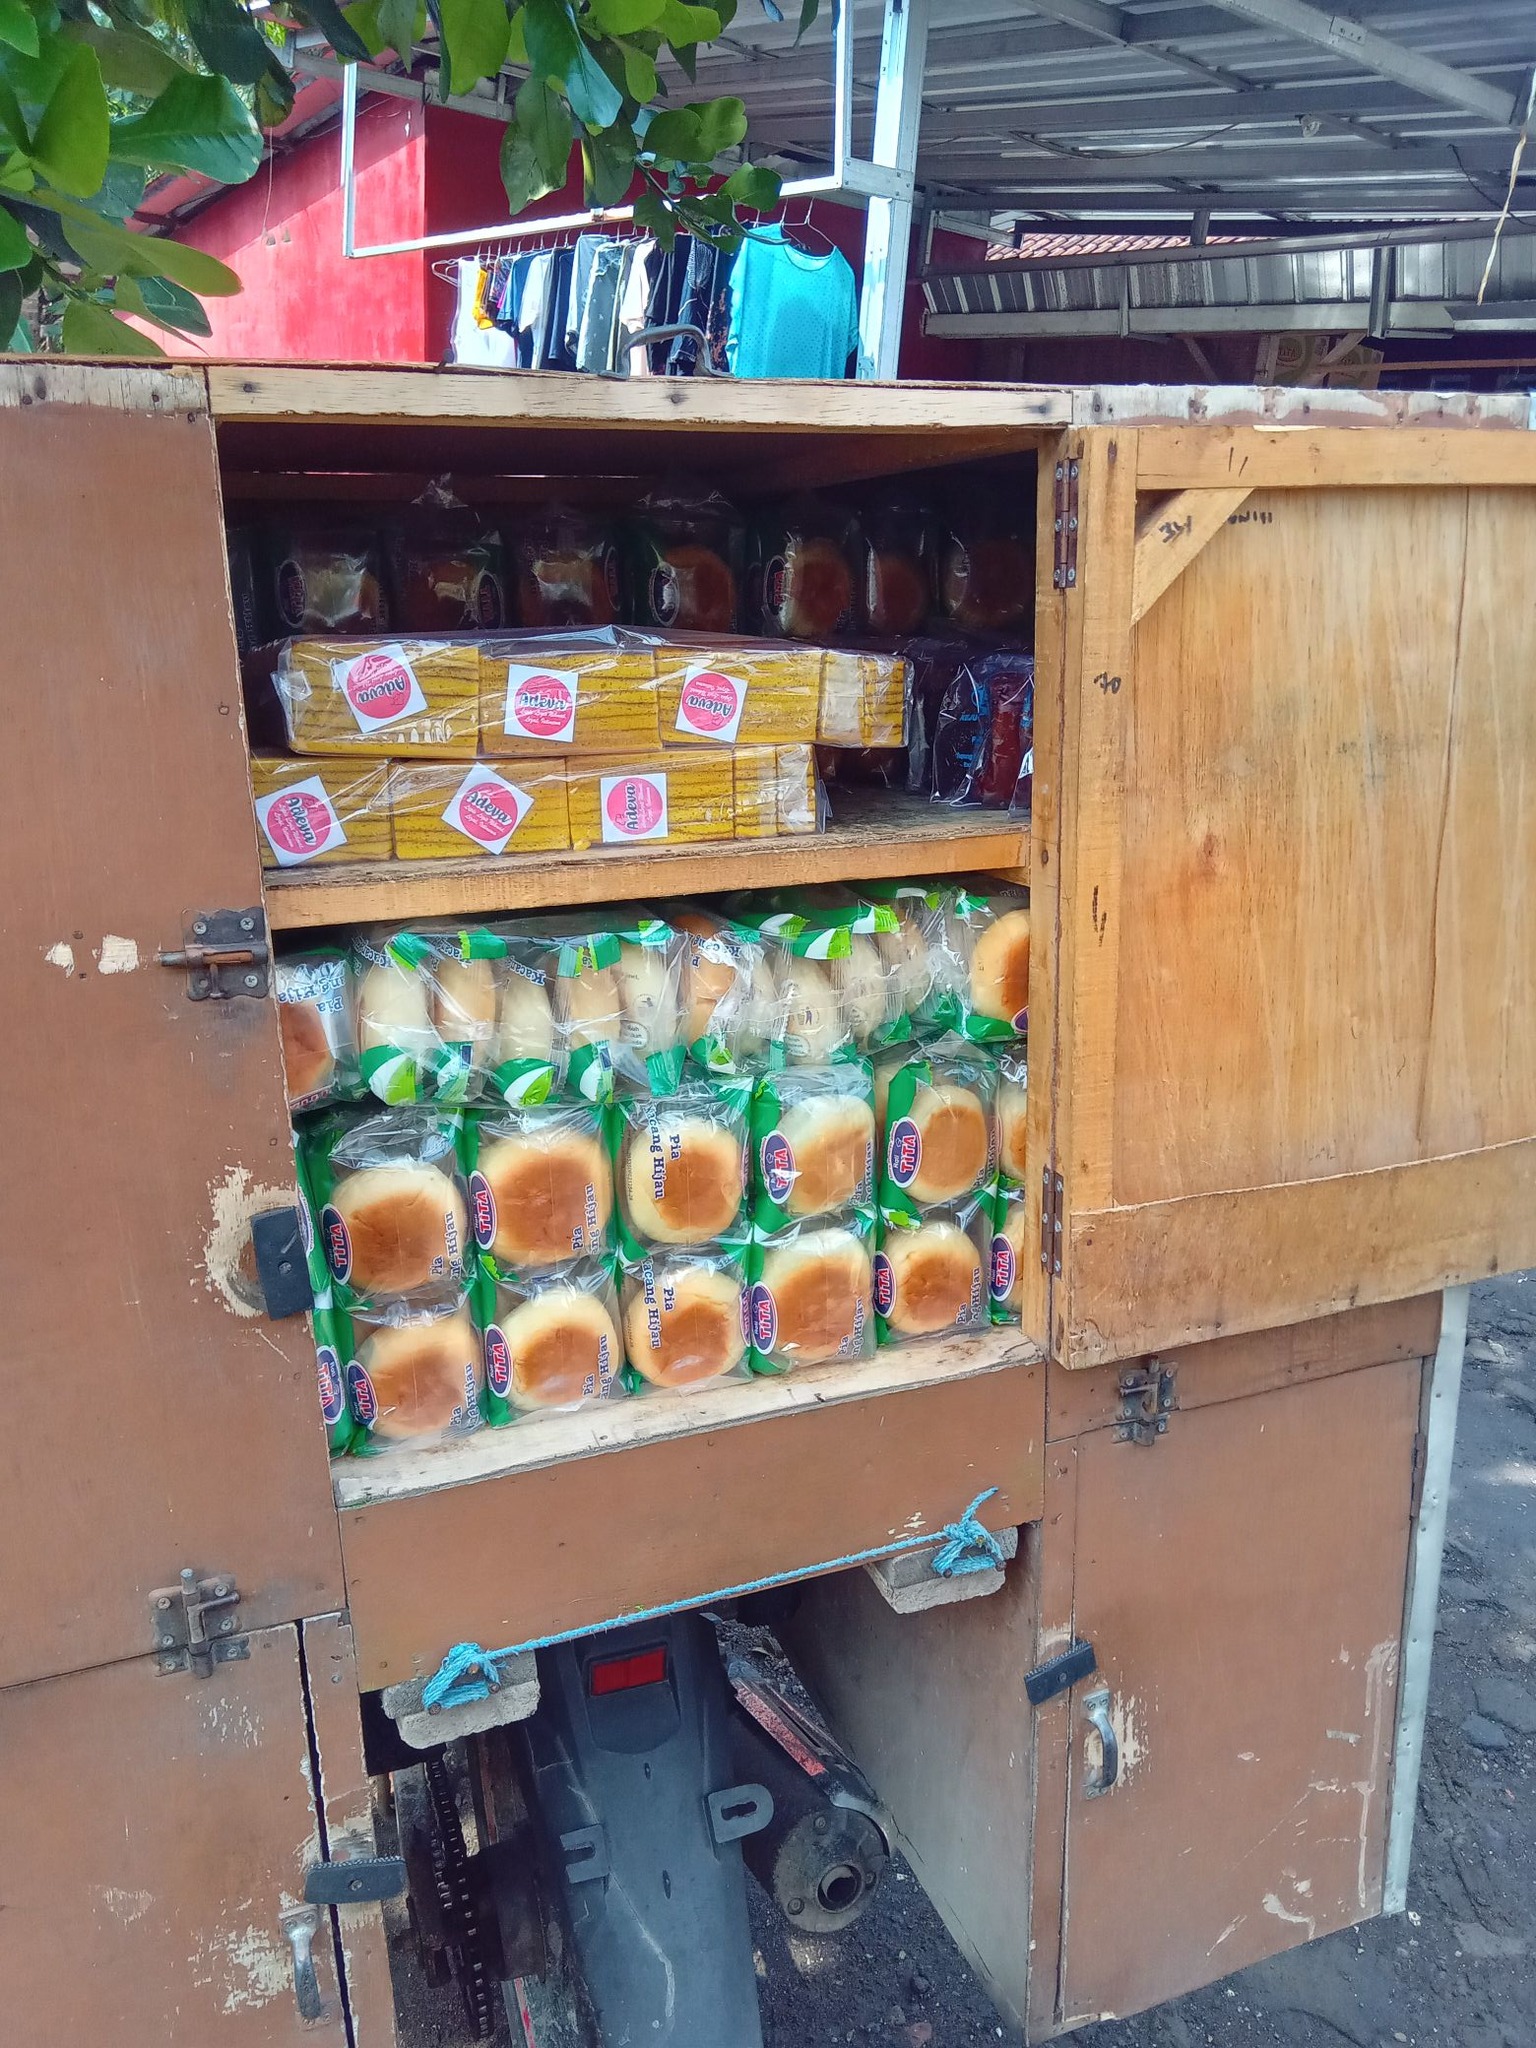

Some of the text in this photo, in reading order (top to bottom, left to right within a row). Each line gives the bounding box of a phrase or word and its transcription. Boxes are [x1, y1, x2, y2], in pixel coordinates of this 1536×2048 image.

[357, 675, 406, 704] Adeva
[519, 692, 566, 711] Adeva
[686, 694, 733, 717] Adeva
[286, 797, 316, 845] Adeva
[467, 791, 512, 825] Adeva
[626, 782, 639, 831] Adeva
[316, 996, 344, 1013] Pia
[668, 1133, 682, 1161] Pia
[900, 1135, 916, 1174] TITA
[652, 1156, 667, 1200] Hijau
[774, 1148, 789, 1189] TTA
[475, 1189, 491, 1234] TITA
[584, 1182, 598, 1229] Hijau
[330, 1223, 348, 1268] TITA
[445, 1210, 458, 1257] Hijau
[571, 1225, 584, 1250] Pia
[430, 1255, 443, 1276] Pia
[995, 1250, 1010, 1287] TITA
[663, 1287, 675, 1312] Pia
[878, 1267, 890, 1305] TITA
[971, 1267, 981, 1307] Hijau
[648, 1307, 662, 1349] Hijau
[758, 1299, 772, 1340] TITA
[956, 1303, 967, 1324] Pia
[491, 1342, 508, 1384] TITA
[597, 1334, 610, 1376] Hijau
[318, 1362, 334, 1408] TITA
[354, 1379, 375, 1418] TITA
[464, 1361, 477, 1409] Hijau
[583, 1373, 594, 1396] Pia
